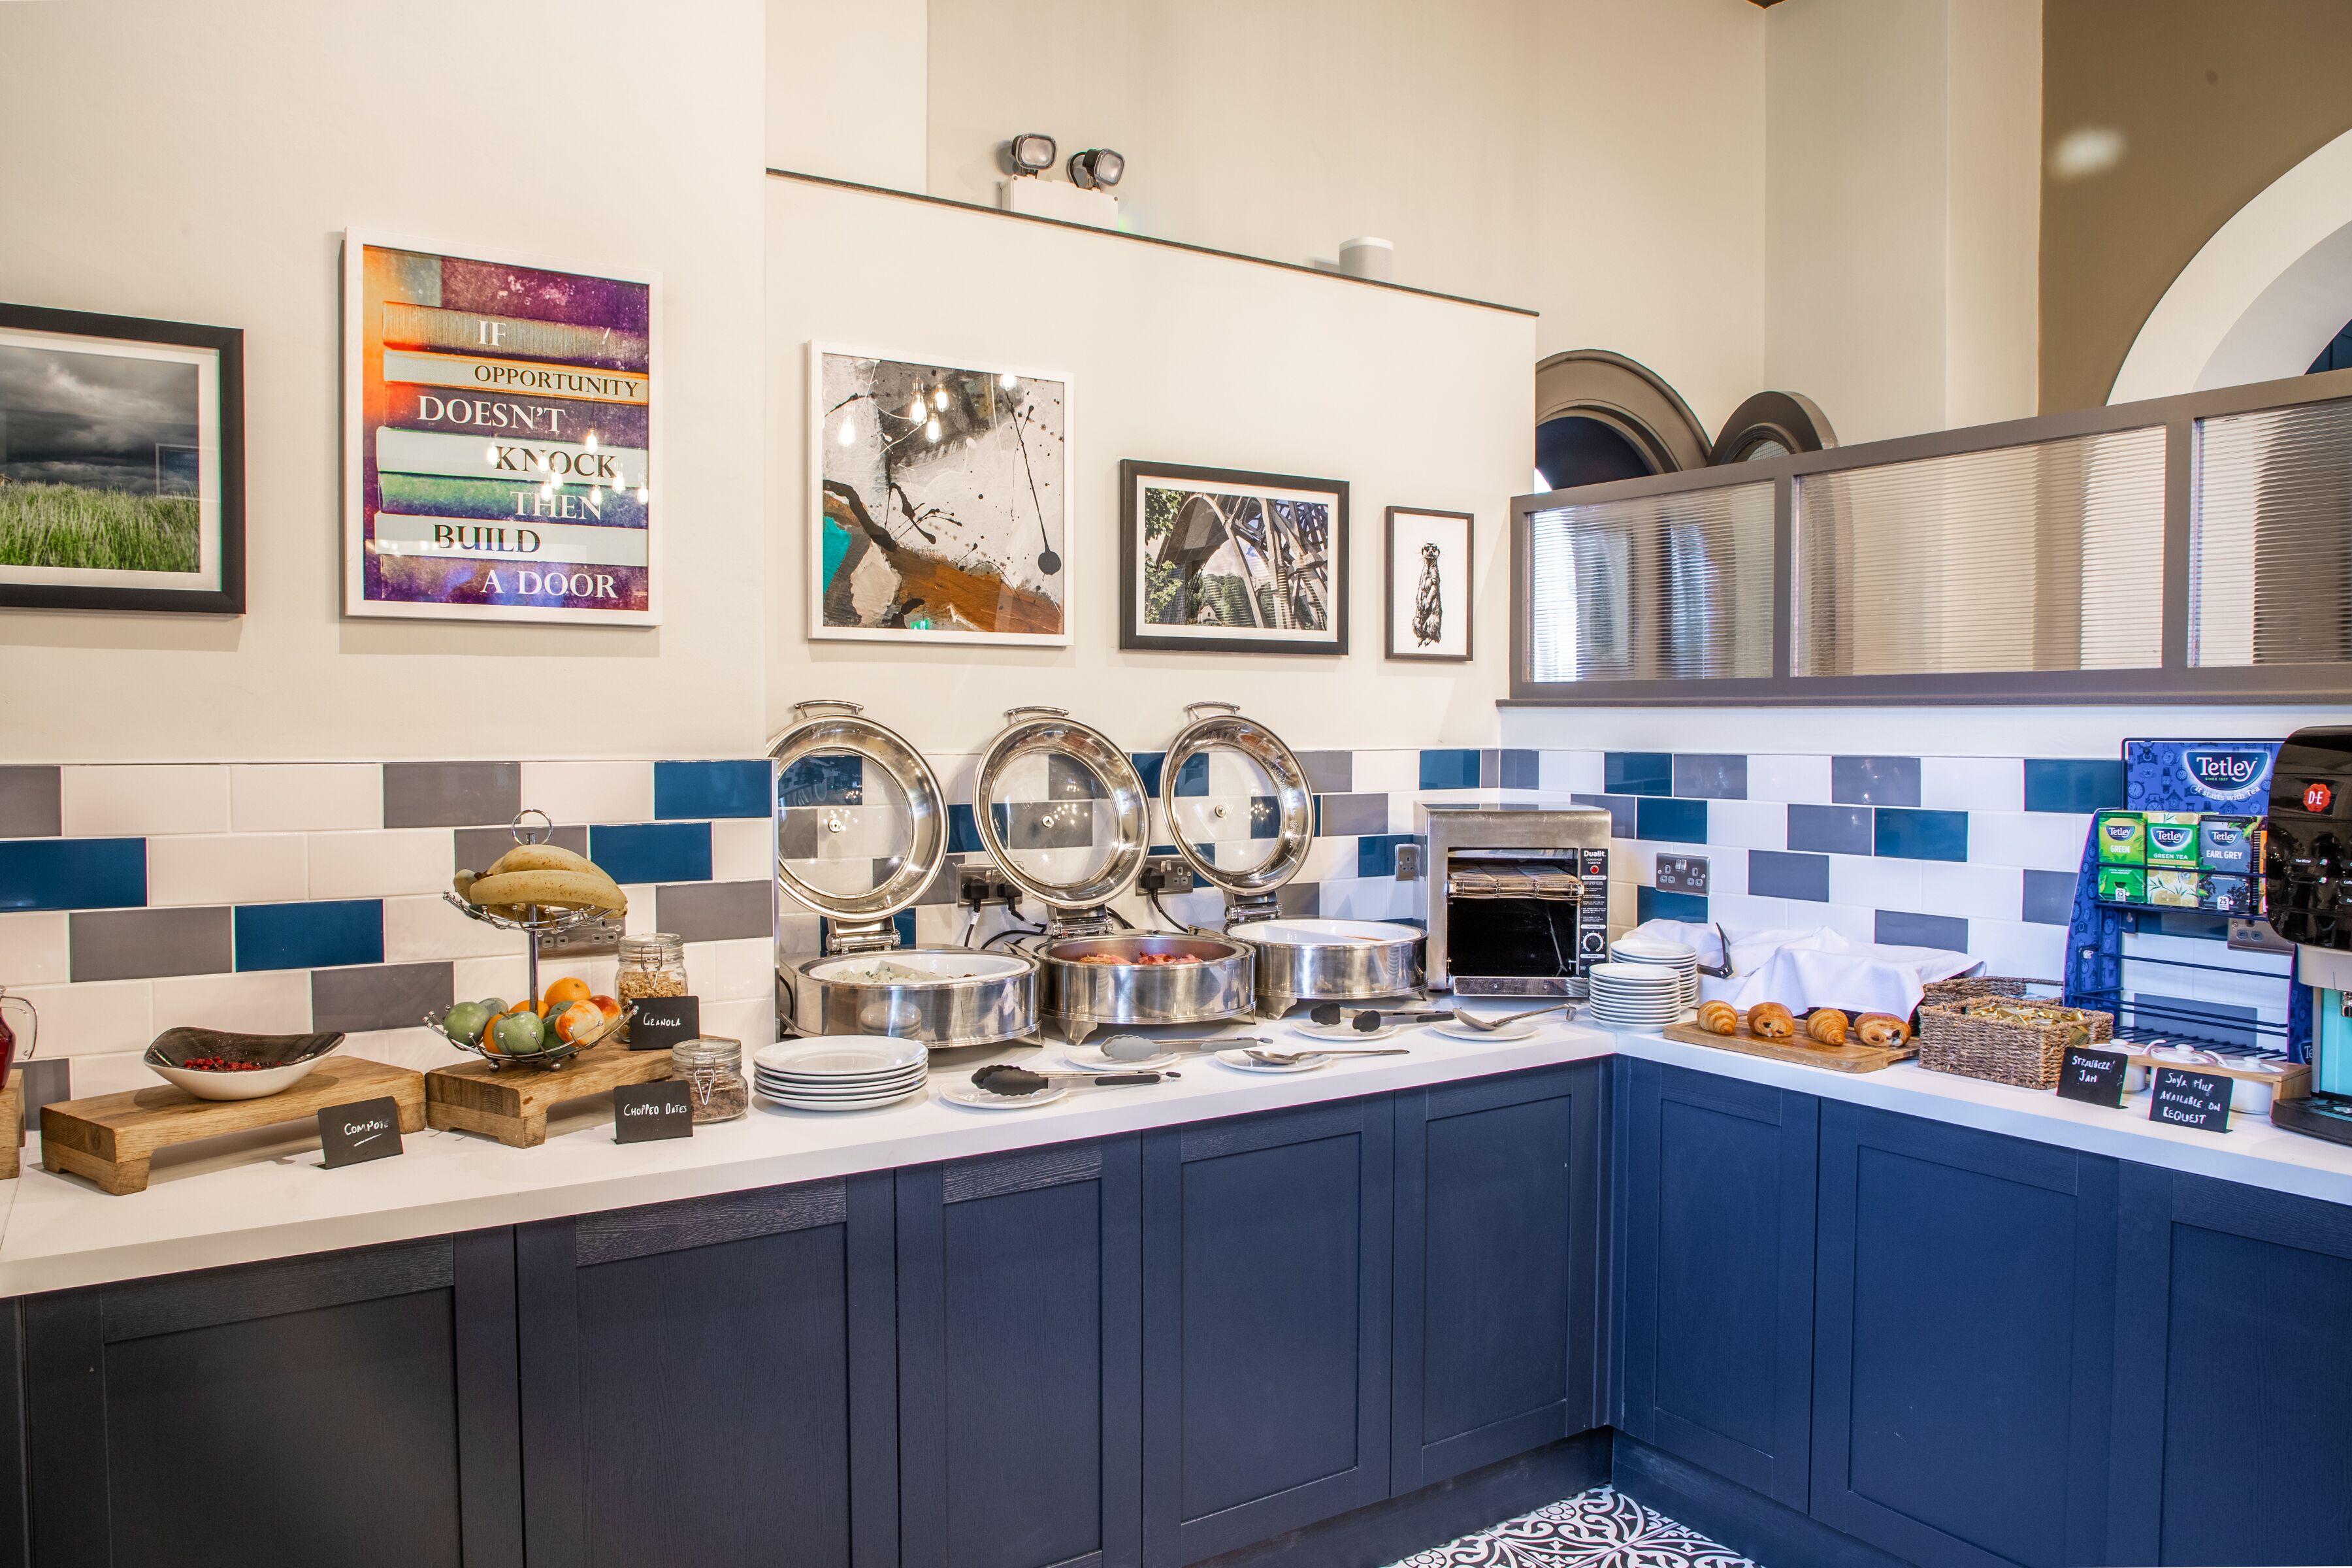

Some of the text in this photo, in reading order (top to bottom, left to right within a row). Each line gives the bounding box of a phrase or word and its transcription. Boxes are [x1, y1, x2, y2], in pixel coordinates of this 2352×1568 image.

[477, 320, 506, 347] IF
[474, 365, 640, 397] OPPORTUNITY
[417, 395, 566, 433] DOESN'T
[494, 446, 617, 479] KNOCK
[510, 491, 602, 521] THEN
[432, 524, 541, 553] BUILD
[480, 569, 618, 599] A DOOR
[2196, 757, 2259, 782] Tetley
[2195, 785, 2202, 794] It
[2202, 791, 2225, 801] starts
[2246, 786, 2261, 796] Tea
[2109, 827, 2131, 838] Tetley
[2156, 830, 2185, 843] Tetley
[2212, 831, 2238, 843] Tetley
[2206, 850, 2242, 860] EARL GREY
[643, 1012, 681, 1027] GRANOLA
[2079, 1070, 2098, 1083] JAM
[623, 1102, 687, 1117] CHOPPED DATES
[2160, 1090, 2221, 1111] AVAILABLE ON
[2163, 1106, 2207, 1124] REQUEST
